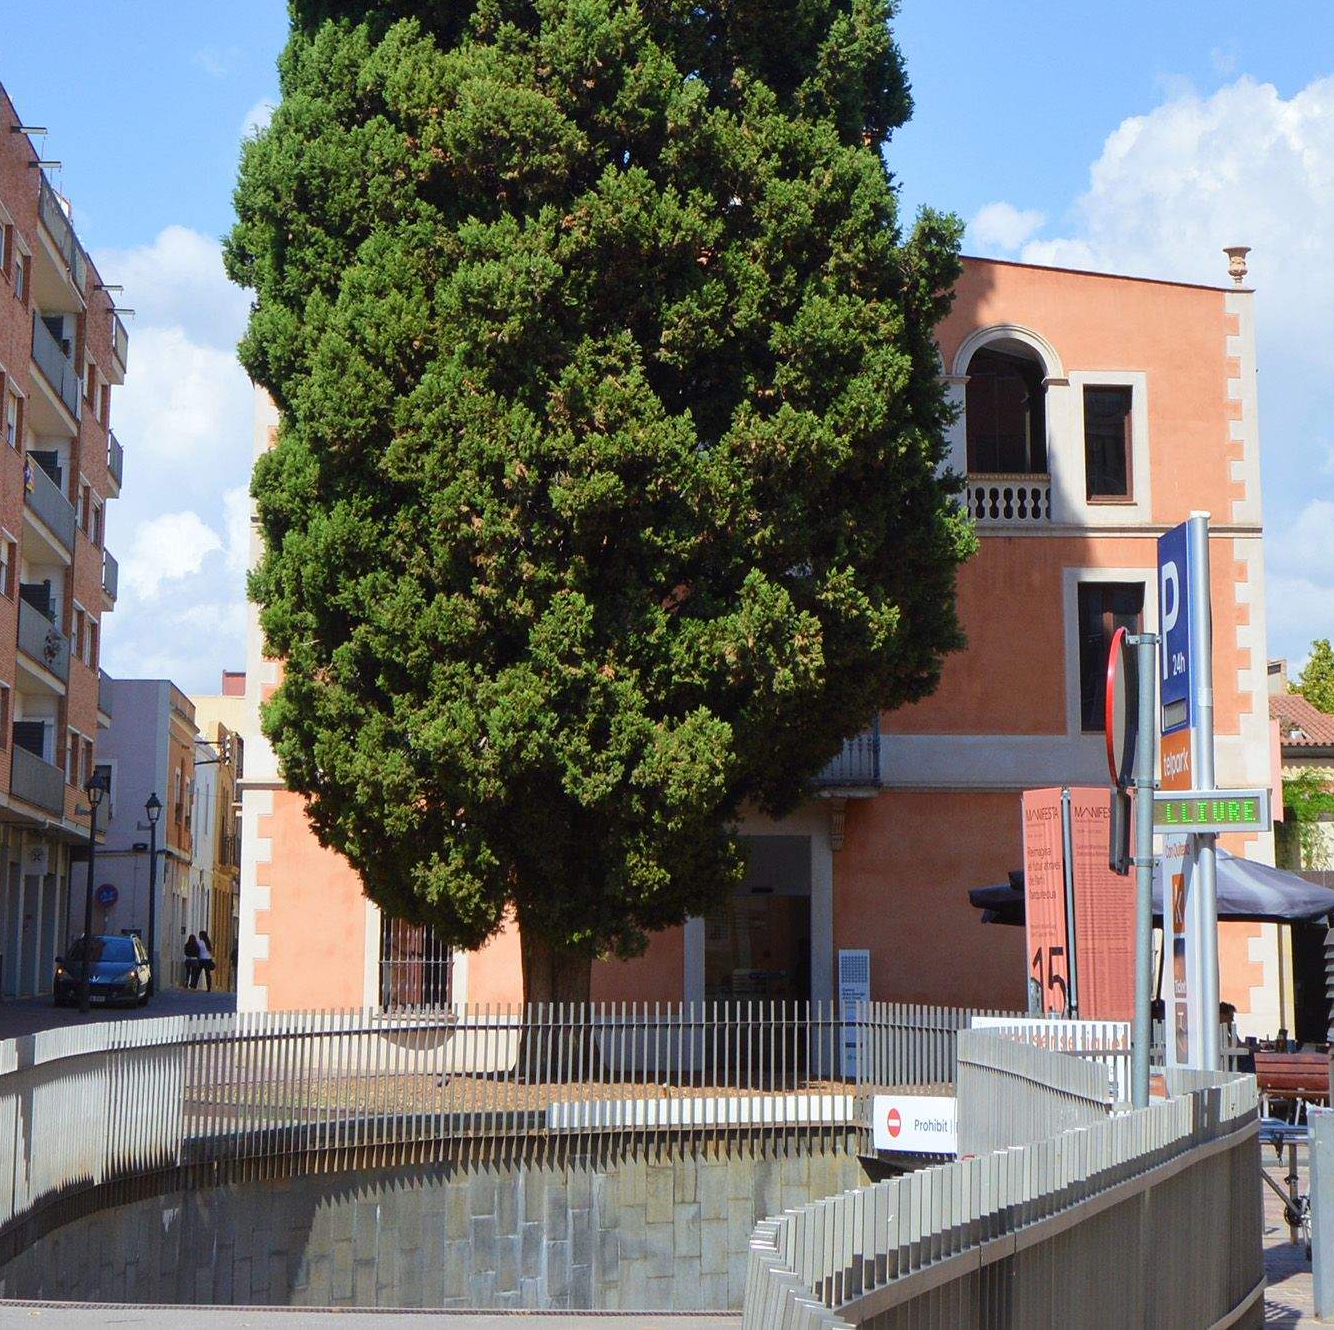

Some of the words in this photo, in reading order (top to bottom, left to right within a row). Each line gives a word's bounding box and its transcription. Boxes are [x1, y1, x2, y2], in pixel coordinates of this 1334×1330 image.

[1162, 561, 1179, 681] P
[1172, 651, 1186, 676] 24h
[1163, 747, 1189, 781] telpark
[1166, 800, 1256, 823] LLIURE
[914, 1119, 948, 1133] Prohibit
